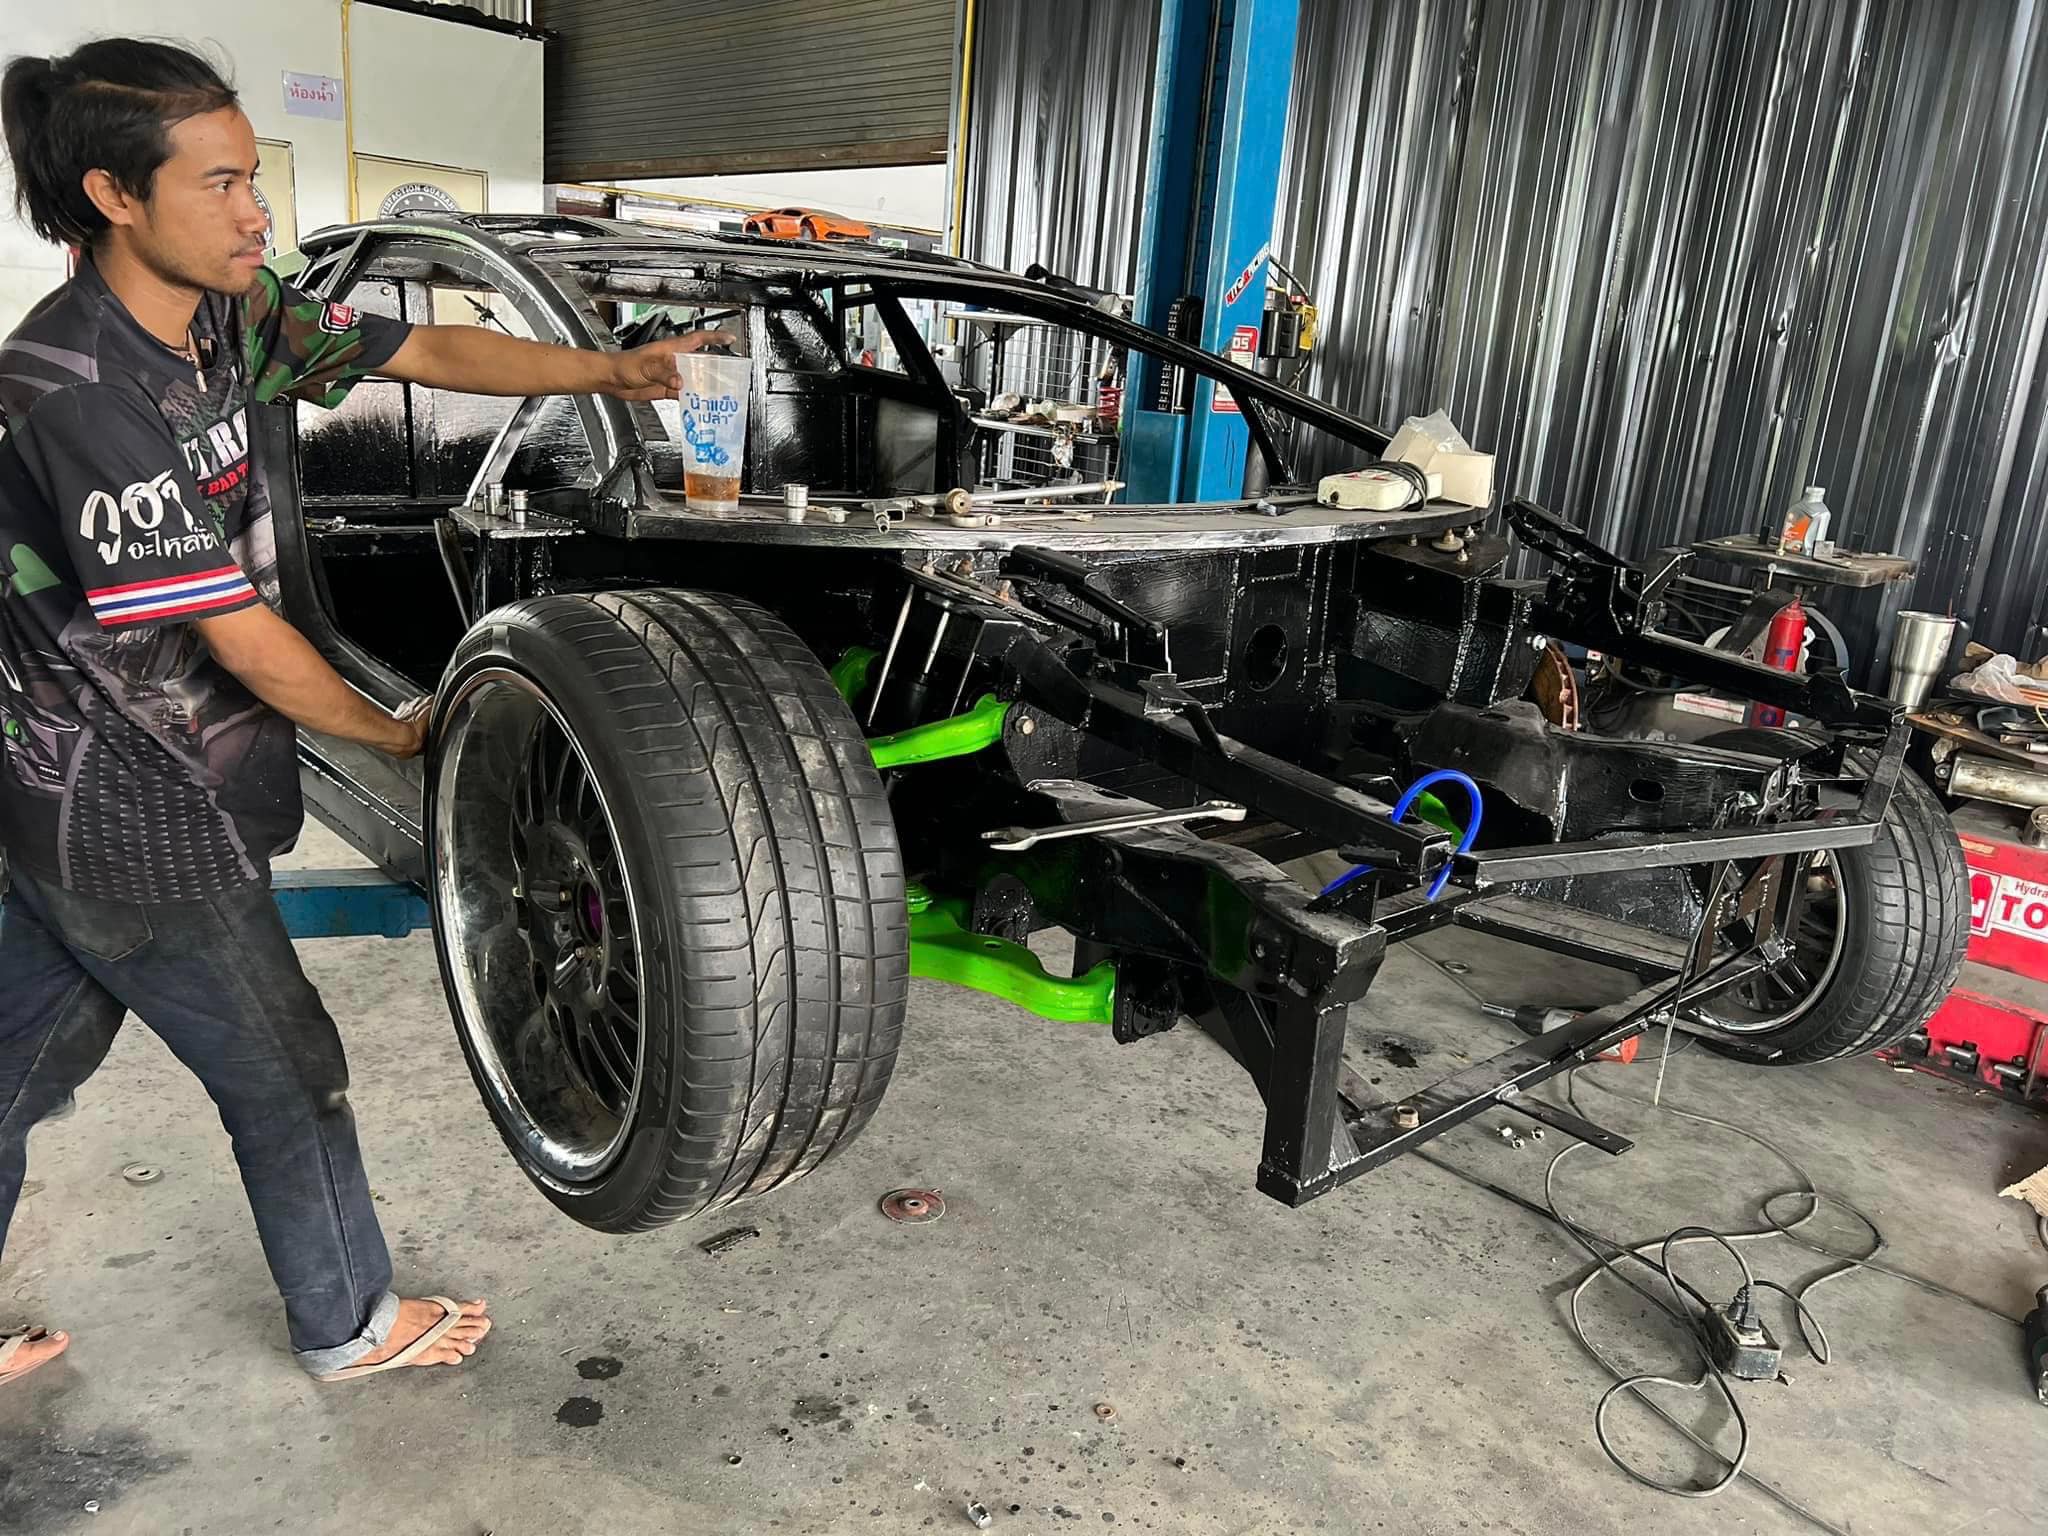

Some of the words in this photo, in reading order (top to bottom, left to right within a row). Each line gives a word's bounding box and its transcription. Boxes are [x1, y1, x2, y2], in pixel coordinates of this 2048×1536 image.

[290, 81, 334, 102] ห้องน้ำ
[381, 184, 421, 216] TISFACTION
[423, 186, 456, 210] GUARAN
